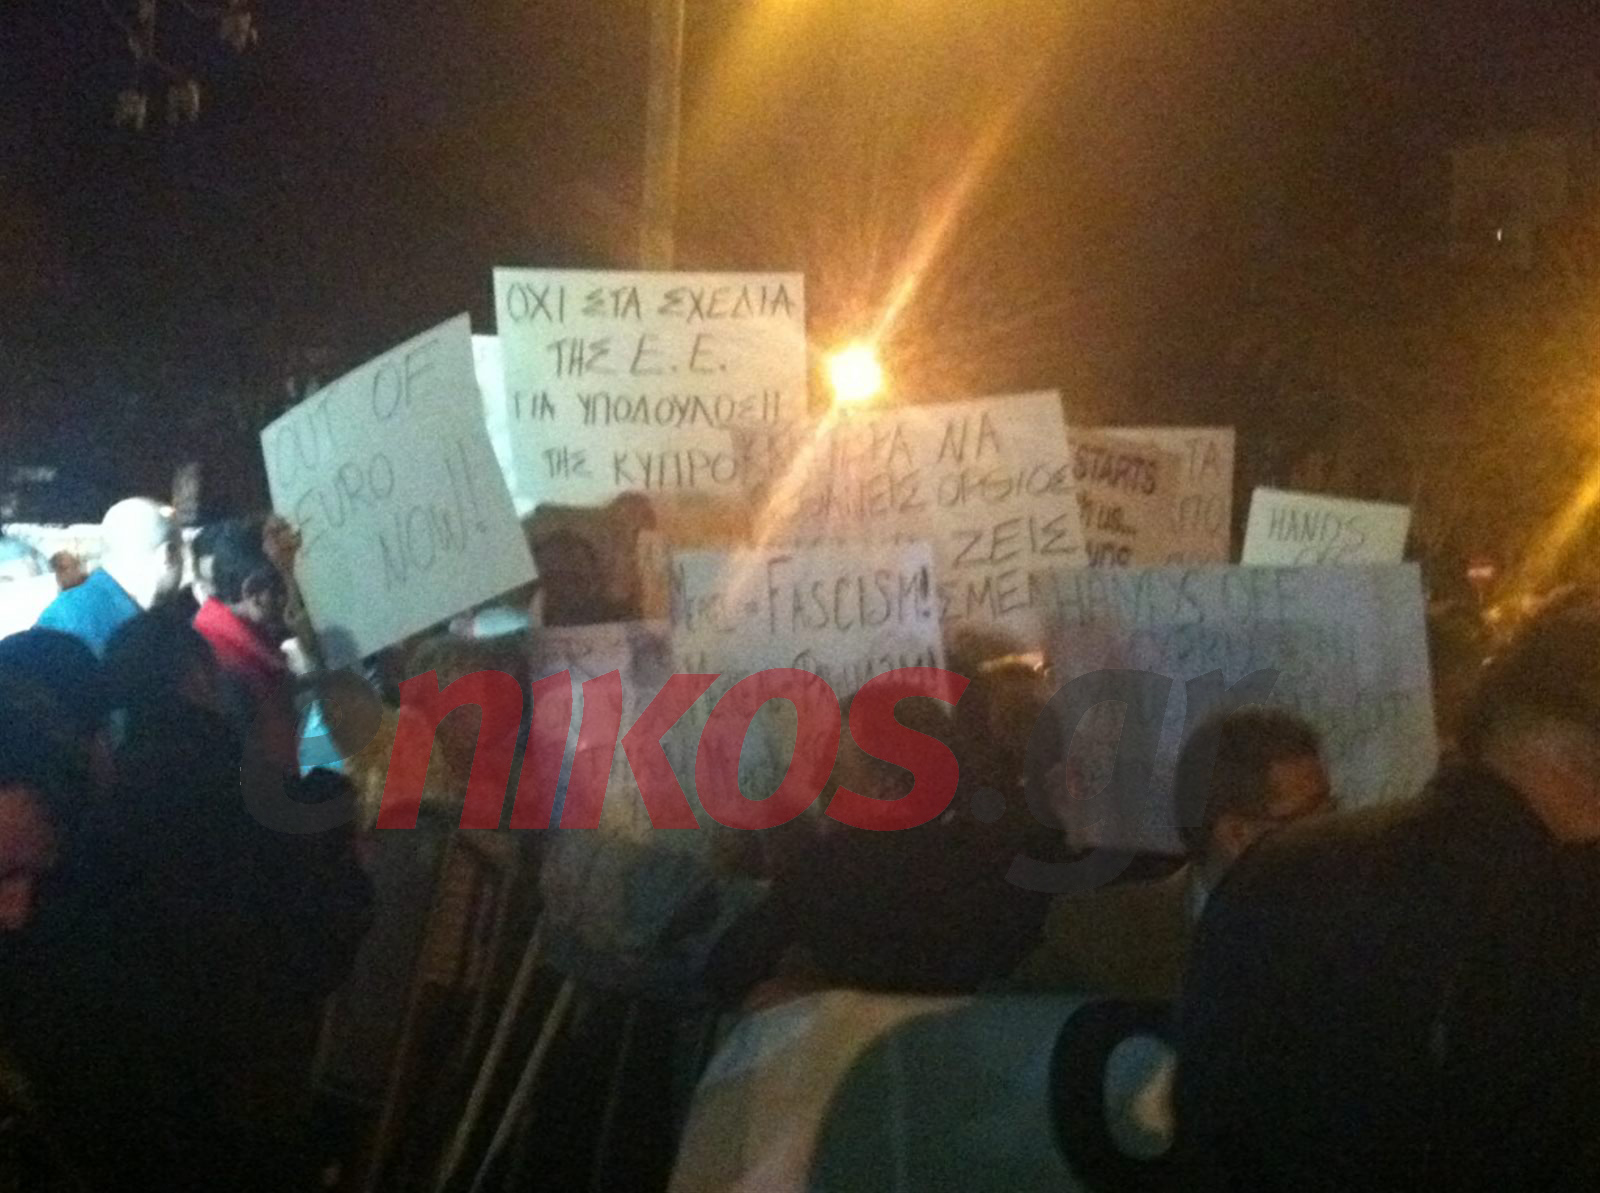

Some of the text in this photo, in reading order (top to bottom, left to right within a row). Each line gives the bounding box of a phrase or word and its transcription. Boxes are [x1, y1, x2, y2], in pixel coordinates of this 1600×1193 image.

[507, 282, 795, 325] ΟΧΙ ΣΤΑ ΣΧΕΔΙΑ
[372, 338, 439, 421] OF
[547, 336, 616, 379] ΤΗΣ
[543, 446, 592, 479] ΤΗΣ
[937, 410, 1000, 464] ΝΑ
[295, 450, 396, 557] EURO
[950, 513, 1081, 570] ΖΕΙΣ
[1267, 506, 1366, 554] HANDS
